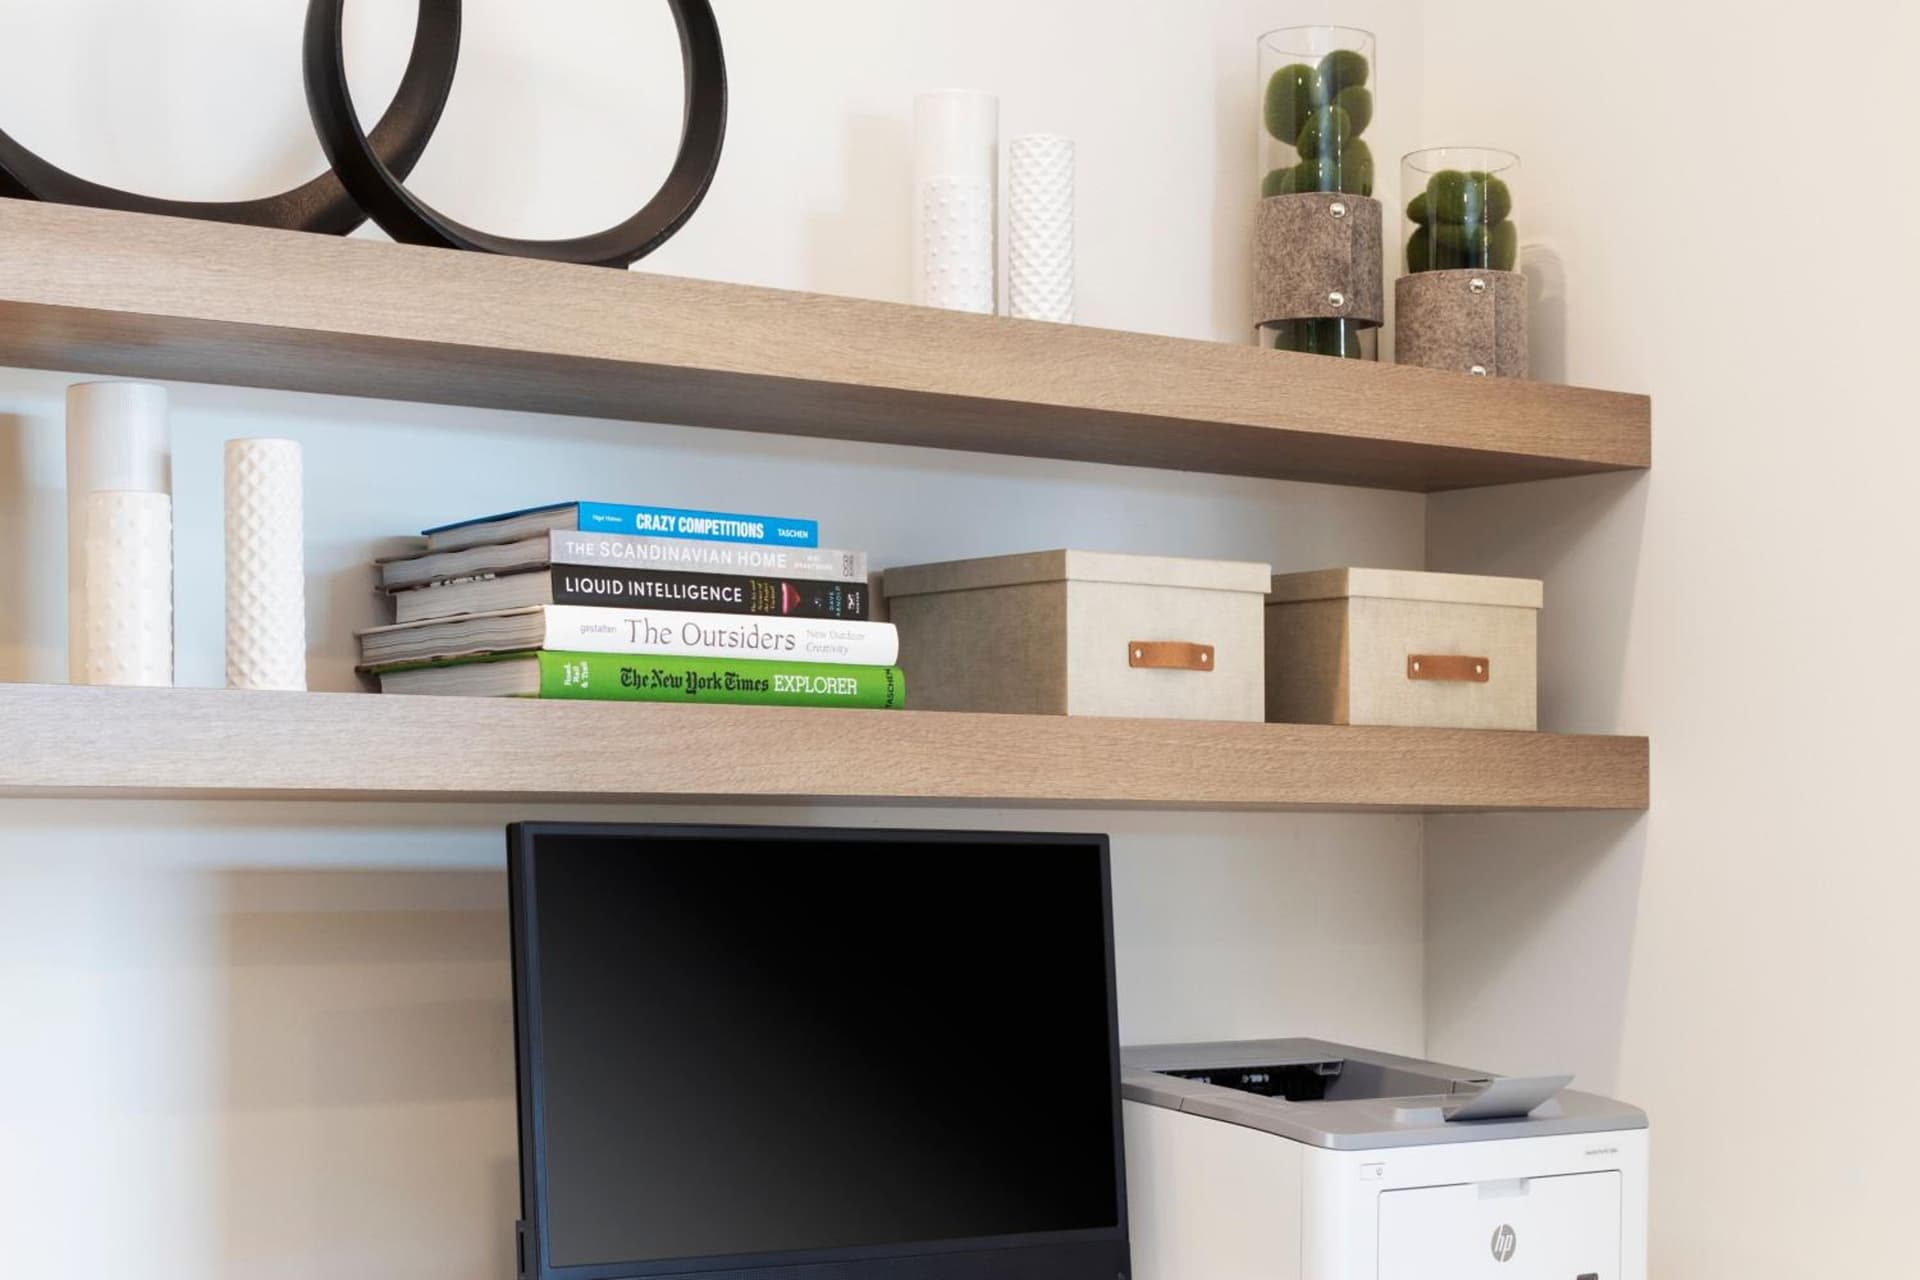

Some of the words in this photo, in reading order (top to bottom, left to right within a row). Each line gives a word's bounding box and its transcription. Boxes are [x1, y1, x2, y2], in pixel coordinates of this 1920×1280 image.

[636, 513, 676, 533] CRAZY
[678, 517, 764, 539] COMPETITIONS
[777, 528, 809, 539] TASCHEN
[566, 542, 595, 556] THE
[600, 542, 731, 564] SCANDINAVIAN
[738, 551, 788, 568] HOME
[565, 576, 623, 595] LIQUID
[628, 580, 742, 602] INTELLIGENCE
[580, 624, 617, 635] gestalten
[624, 617, 672, 645] The
[682, 622, 796, 650] Outsiders
[620, 667, 648, 690] The
[651, 669, 683, 689] New
[685, 671, 722, 695] York
[724, 672, 769, 692] Times
[774, 674, 858, 695] EXPLORER
[886, 668, 895, 708] TASCHEN
[1492, 1224, 1516, 1262] hp
